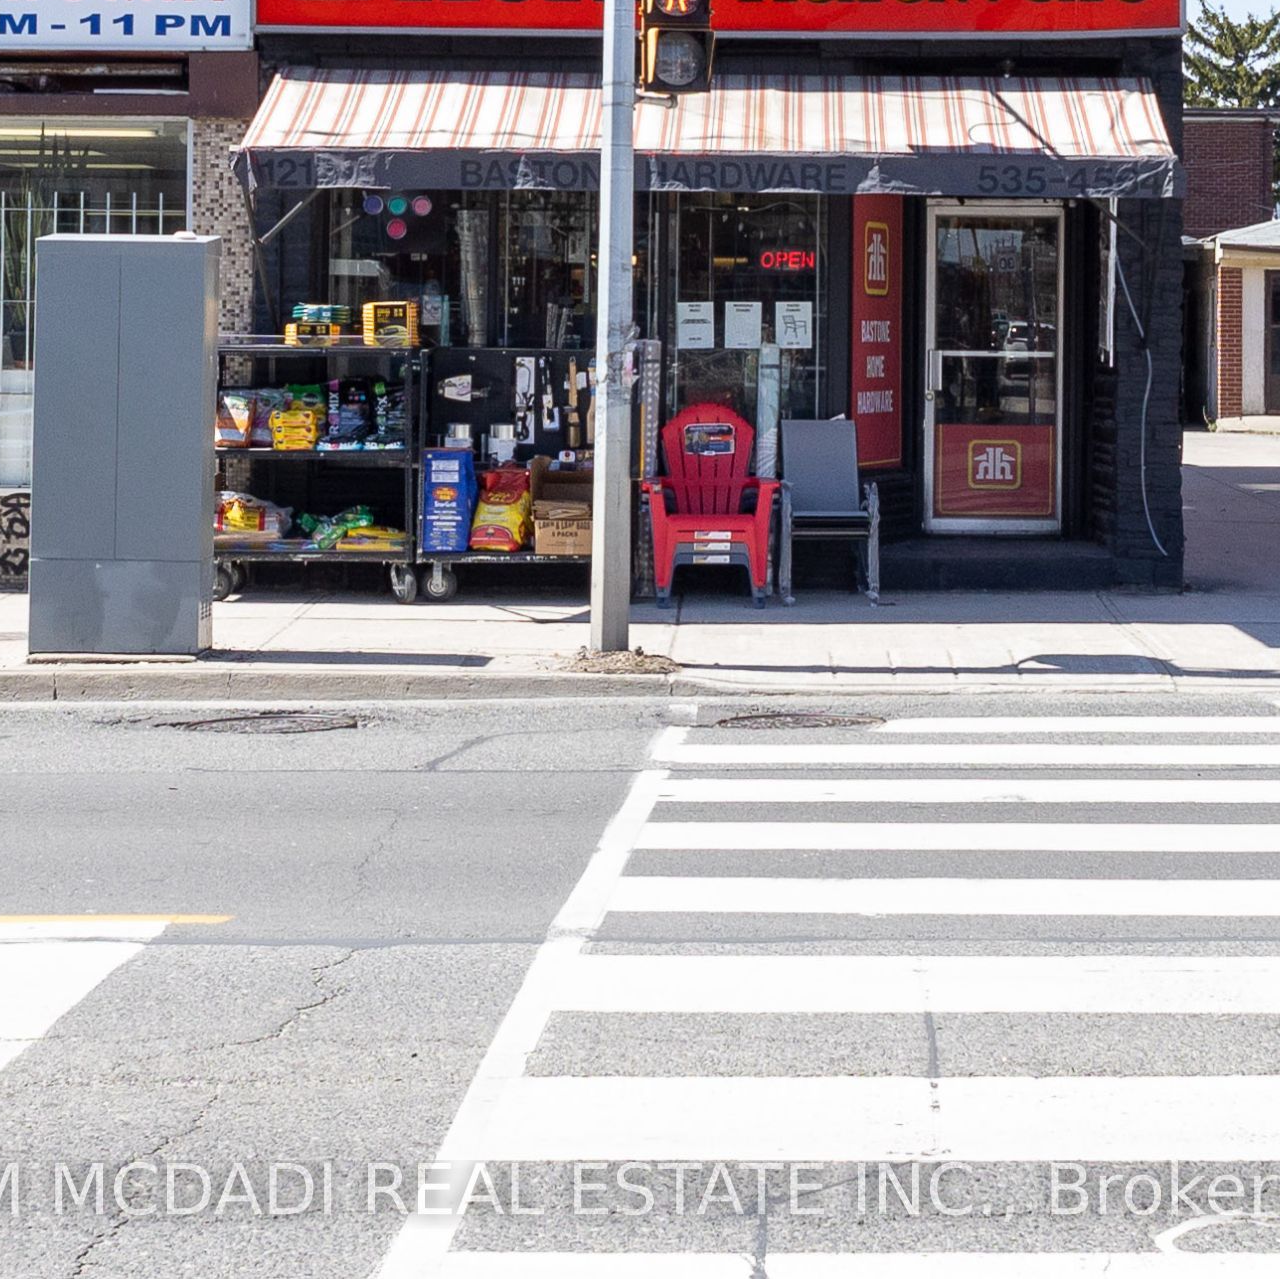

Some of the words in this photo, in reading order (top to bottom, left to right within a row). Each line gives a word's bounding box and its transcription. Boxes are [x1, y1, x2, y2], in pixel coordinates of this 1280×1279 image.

[459, 160, 602, 189] BASTON
[645, 160, 847, 191] HARDWARE
[760, 251, 815, 269] OPEN
[861, 320, 890, 342] BASTONE
[866, 355, 885, 378] HOME
[857, 390, 893, 414] HARDWARE
